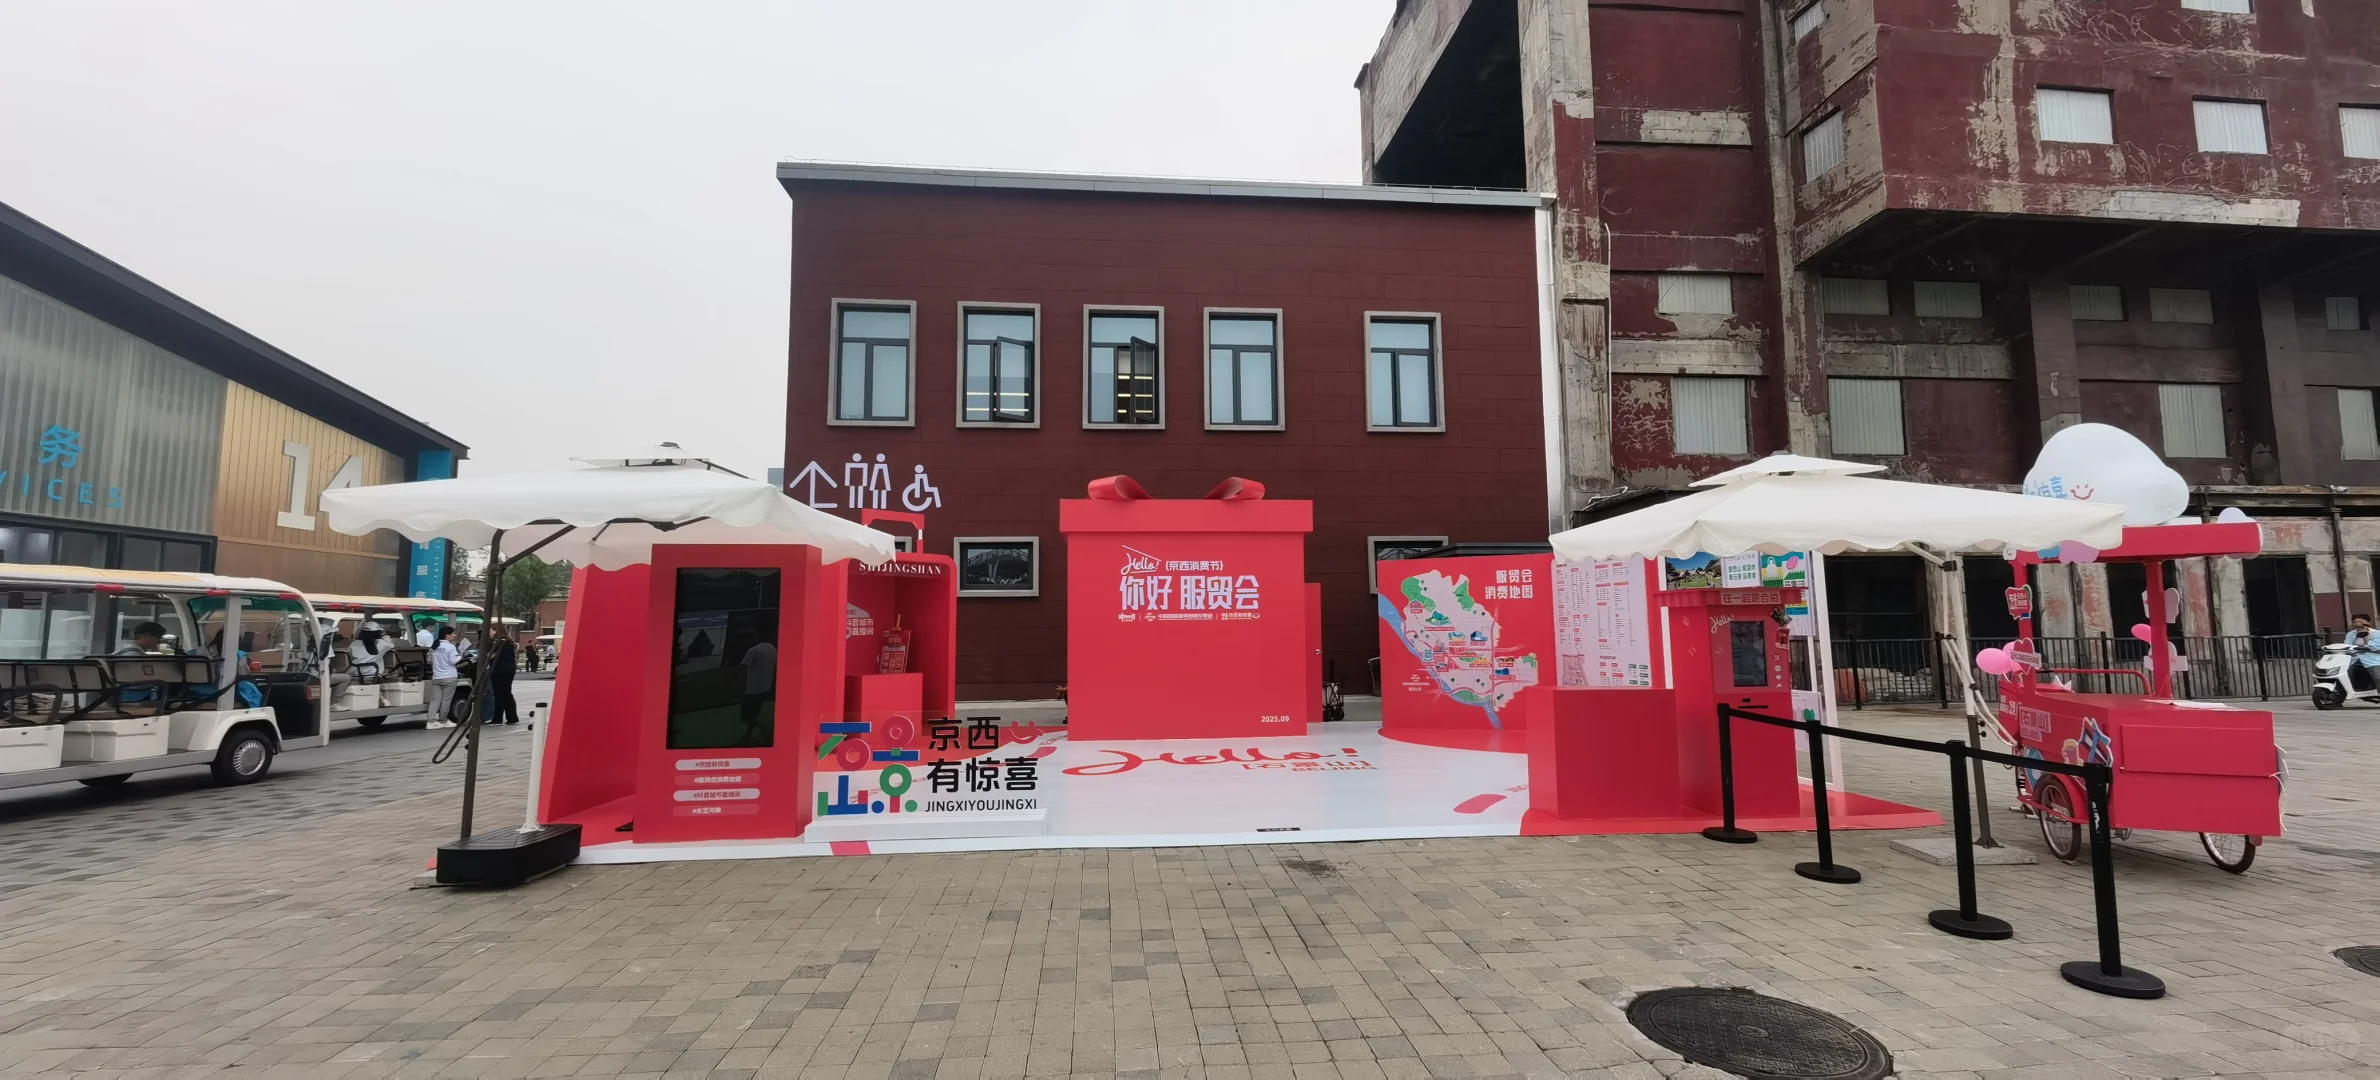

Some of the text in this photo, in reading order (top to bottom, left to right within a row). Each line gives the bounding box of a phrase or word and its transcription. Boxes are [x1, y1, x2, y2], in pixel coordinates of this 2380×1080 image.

[38, 424, 83, 468] 务
[1120, 552, 1160, 575] Hello!
[1496, 568, 1533, 584] 服贸会
[1119, 574, 1260, 610] 你好 服贸会
[1485, 584, 1534, 600] 消费地图
[1260, 715, 1291, 723] 2025.09
[928, 716, 1002, 751] 京西
[1062, 748, 1359, 775] Hello!
[927, 756, 1039, 793] 有惊喜
[925, 798, 1038, 813] JINGXIYOUJINGXI
